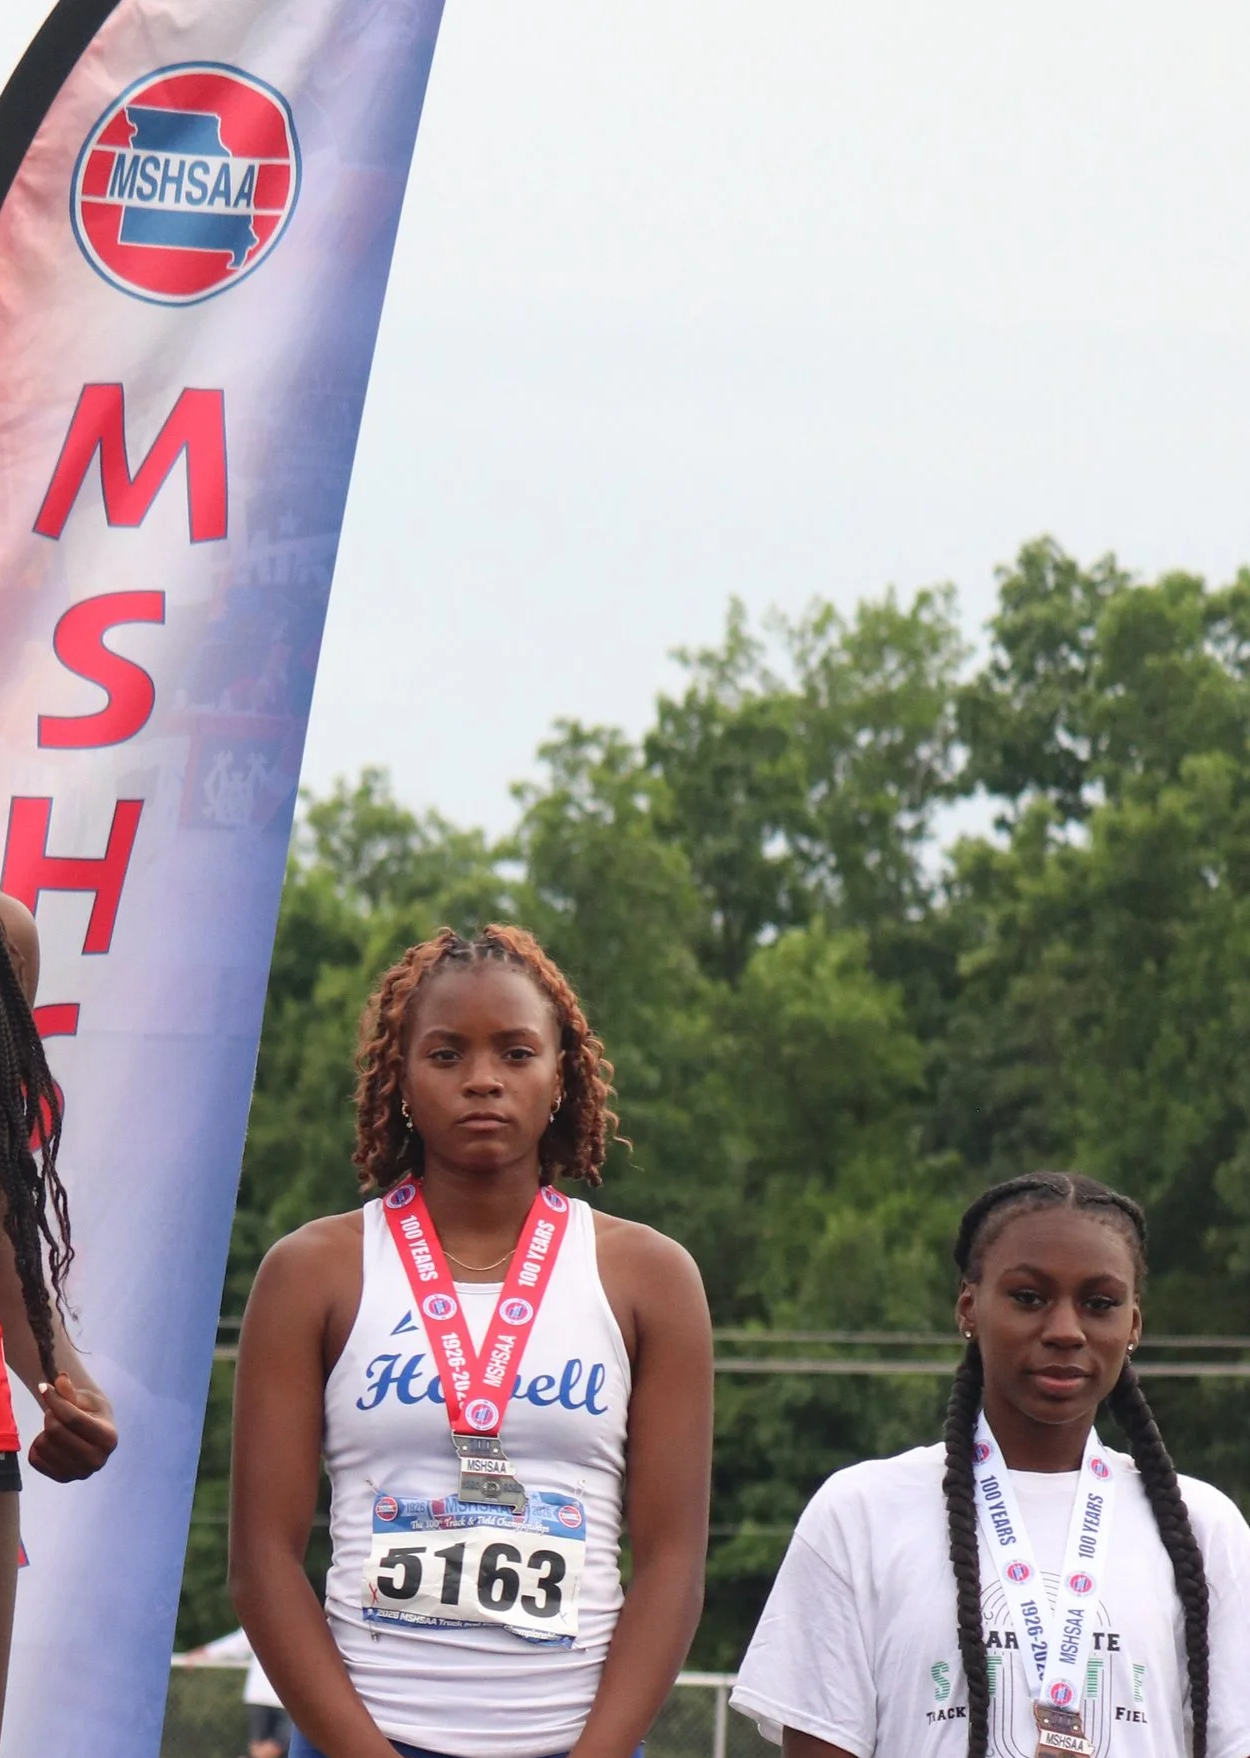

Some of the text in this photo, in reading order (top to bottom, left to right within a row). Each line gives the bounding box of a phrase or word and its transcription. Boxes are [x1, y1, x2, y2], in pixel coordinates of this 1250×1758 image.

[108, 152, 256, 210] MSHSAA
[399, 1214, 439, 1283] 100 YEARS
[517, 1219, 556, 1288] 100 YEARS
[356, 1353, 609, 1415] Hoell
[440, 1331, 471, 1410] 1926-20
[482, 1334, 517, 1388] MSHSAA
[467, 1460, 507, 1473] MSHSAA
[445, 1516, 467, 1527] Track
[979, 1474, 1017, 1547] 100 YEARS
[1077, 1492, 1104, 1559] 100 YEARS
[376, 1542, 566, 1619] 5163
[401, 1612, 438, 1626] MSHSAA
[1020, 1599, 1049, 1681] 1926-20
[1058, 1608, 1085, 1665] MSHSAA
[926, 1706, 1148, 1726] TACK FIEL
[1046, 1733, 1084, 1752] MSHSAA
